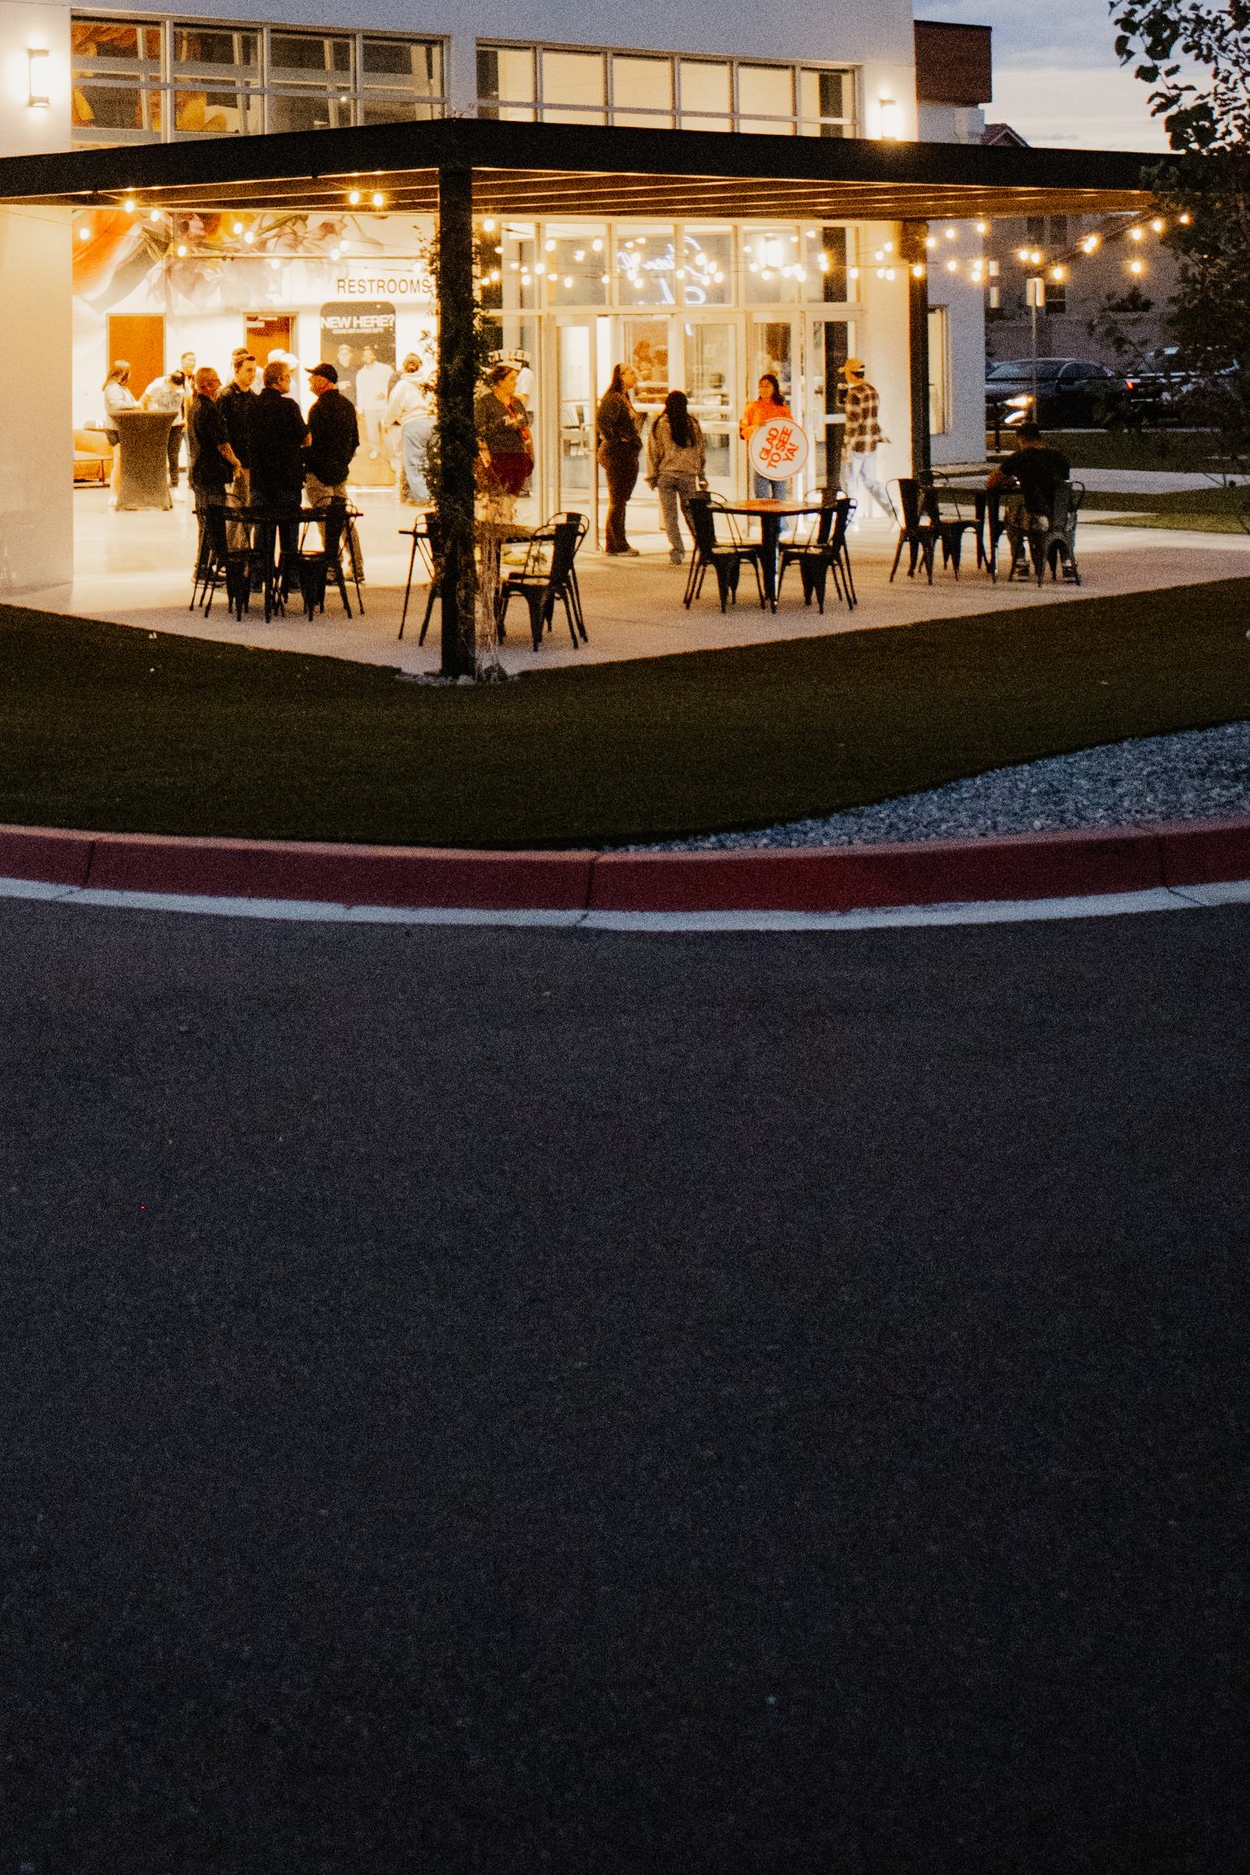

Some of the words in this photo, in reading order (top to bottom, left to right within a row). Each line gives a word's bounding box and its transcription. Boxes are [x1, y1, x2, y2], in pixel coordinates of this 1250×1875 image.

[336, 277, 432, 294] RESTROOMS
[320, 316, 352, 329] NEW
[353, 313, 396, 328] HERE?
[759, 427, 779, 461] GLAD
[766, 452, 781, 469] TO
[775, 425, 793, 452] SEE
[782, 442, 799, 462] YA!
